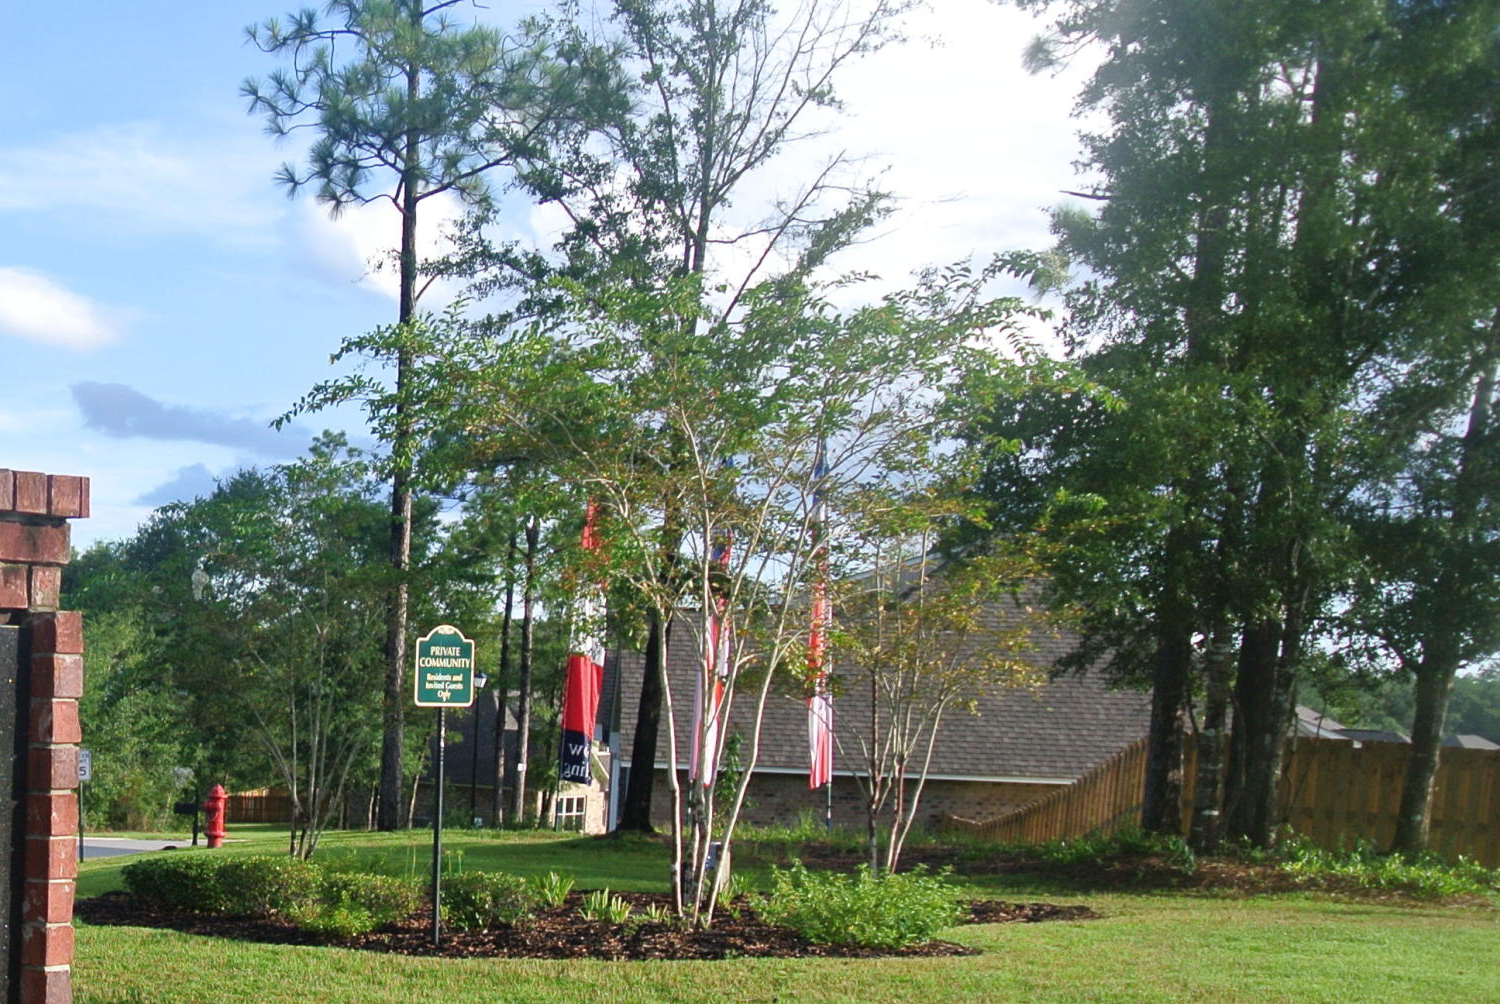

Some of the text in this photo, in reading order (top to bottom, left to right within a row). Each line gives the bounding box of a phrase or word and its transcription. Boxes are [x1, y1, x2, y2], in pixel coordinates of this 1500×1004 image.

[430, 646, 461, 656] PRIVATE
[419, 657, 471, 668] COMMUNITY
[426, 673, 463, 681] Residents and
[425, 681, 445, 689] Invited
[437, 689, 451, 700] Only
